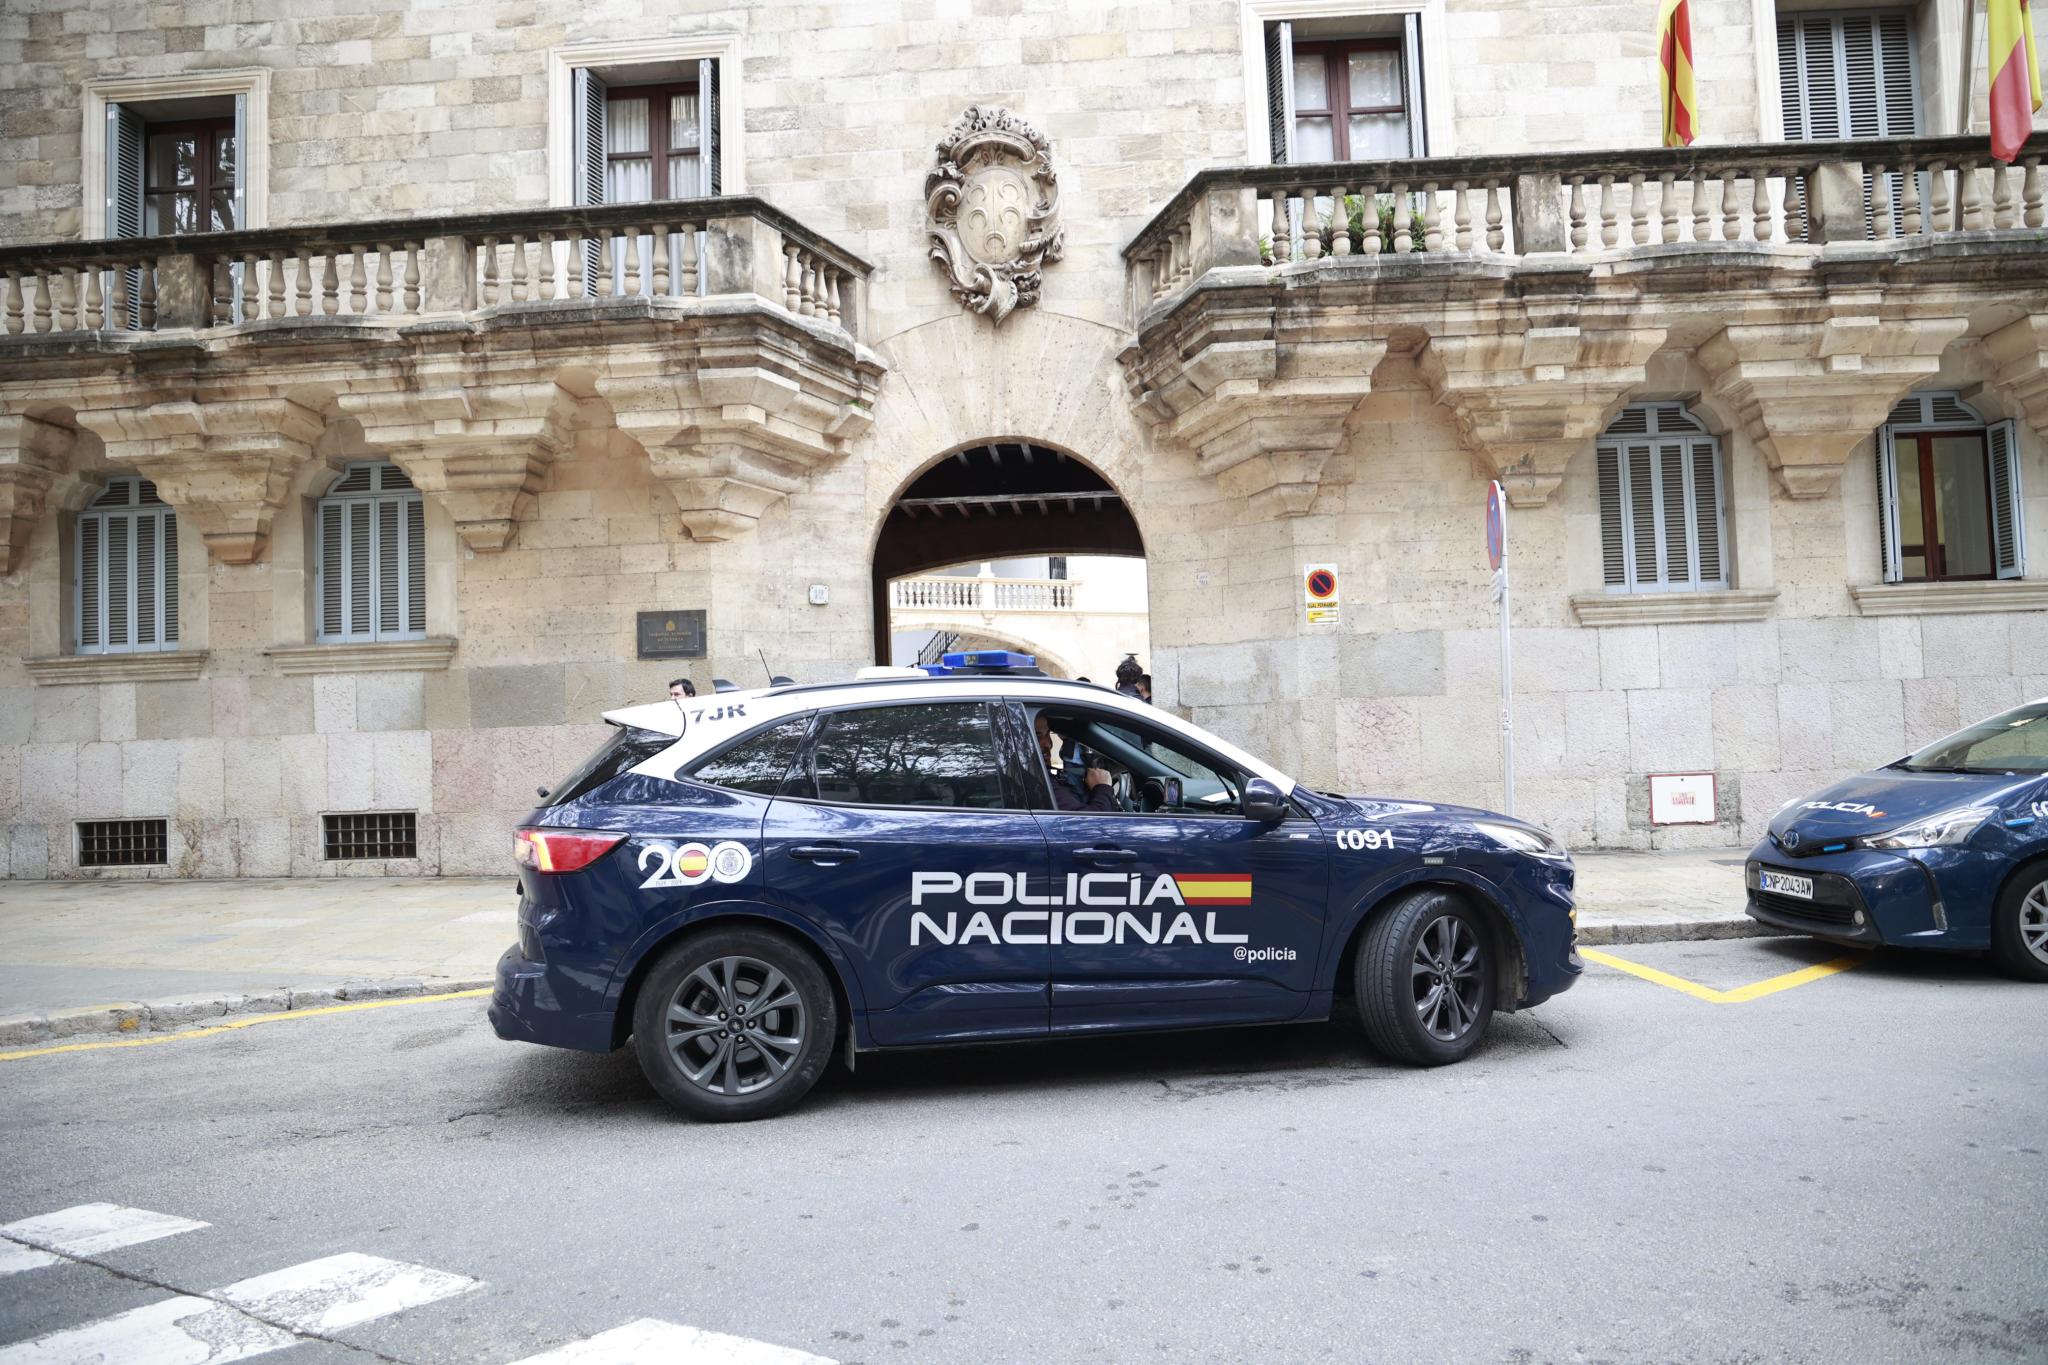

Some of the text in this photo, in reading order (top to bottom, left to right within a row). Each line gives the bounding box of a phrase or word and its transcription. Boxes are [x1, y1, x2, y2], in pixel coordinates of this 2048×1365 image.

[690, 704, 747, 725] 7JK
[638, 841, 752, 889] 200
[910, 911, 1249, 946] NACIONAL
[1233, 946, 1297, 964] @policia
